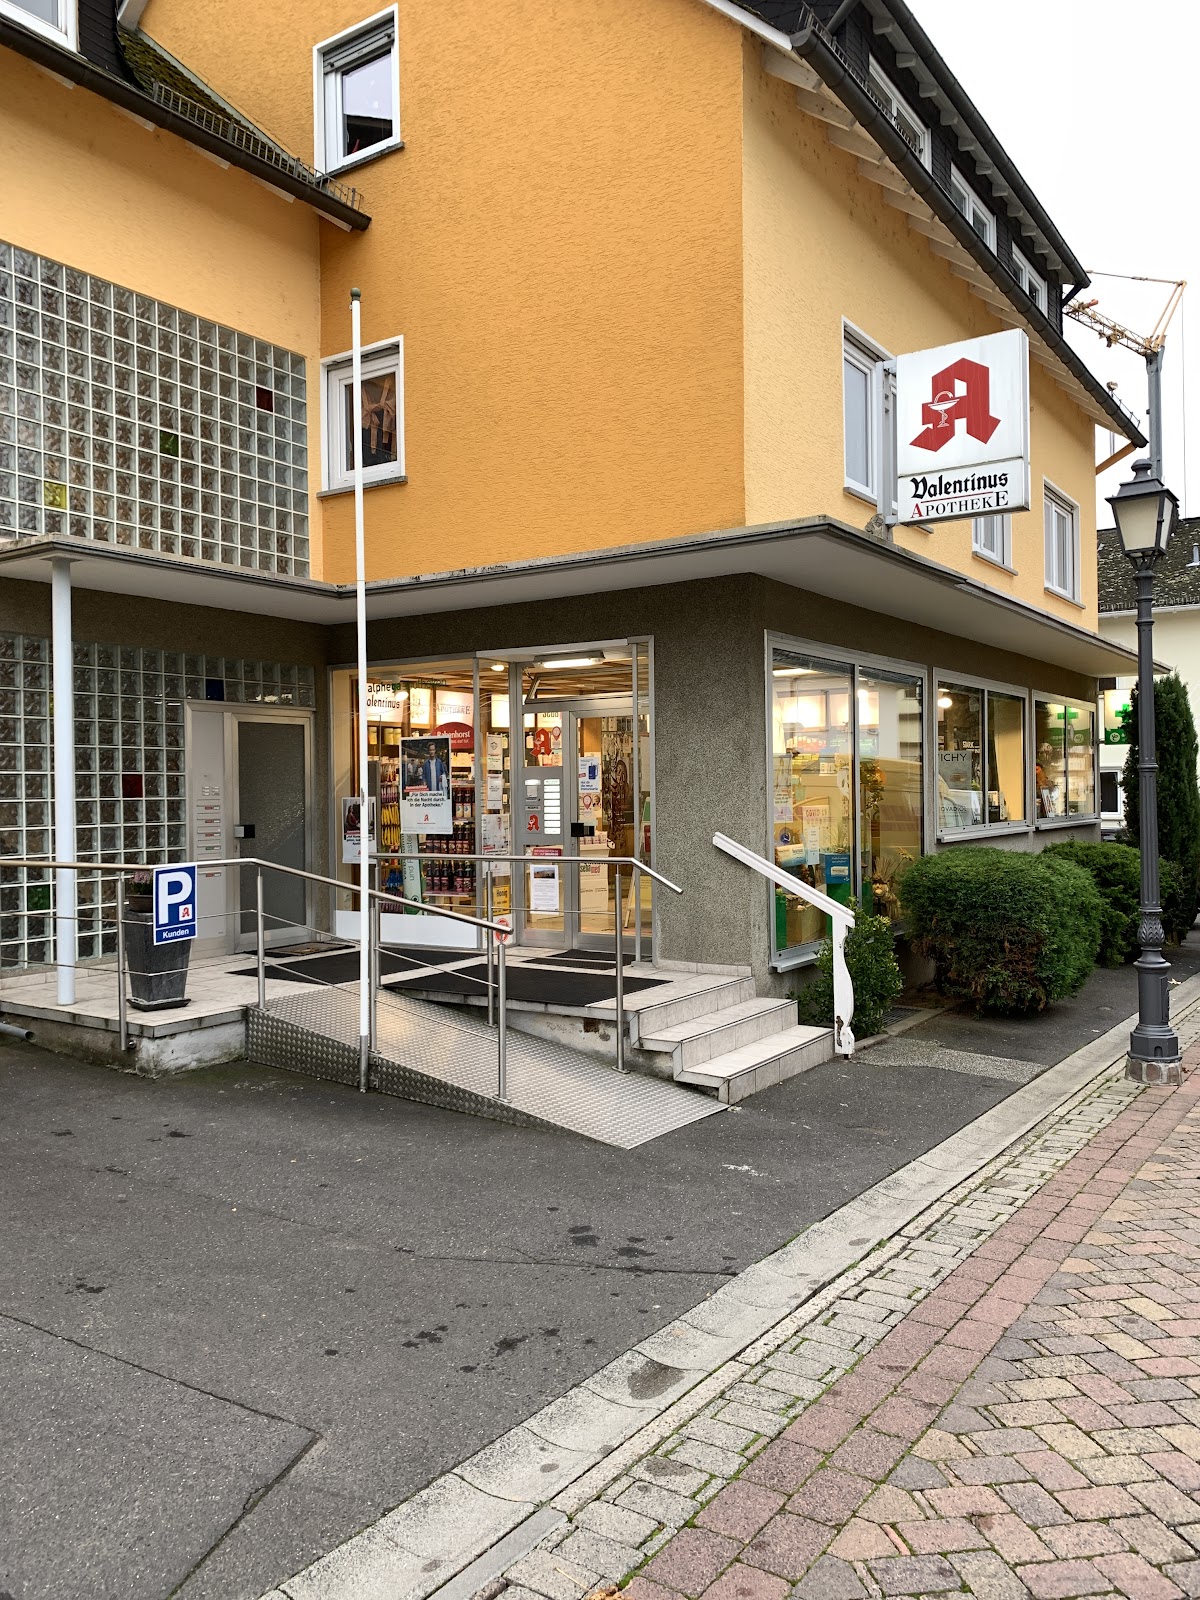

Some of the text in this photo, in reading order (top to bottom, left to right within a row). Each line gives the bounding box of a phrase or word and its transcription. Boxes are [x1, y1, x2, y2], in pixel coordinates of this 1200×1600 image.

[910, 472, 1009, 499] Valentinus
[911, 490, 1009, 519] APOTHEKE
[367, 682, 401, 694] alphega
[366, 695, 400, 709] alentinus
[938, 753, 967, 762] ICHY
[806, 808, 827, 817] COVID-19
[158, 871, 193, 925] P
[162, 928, 190, 939] Kunden
